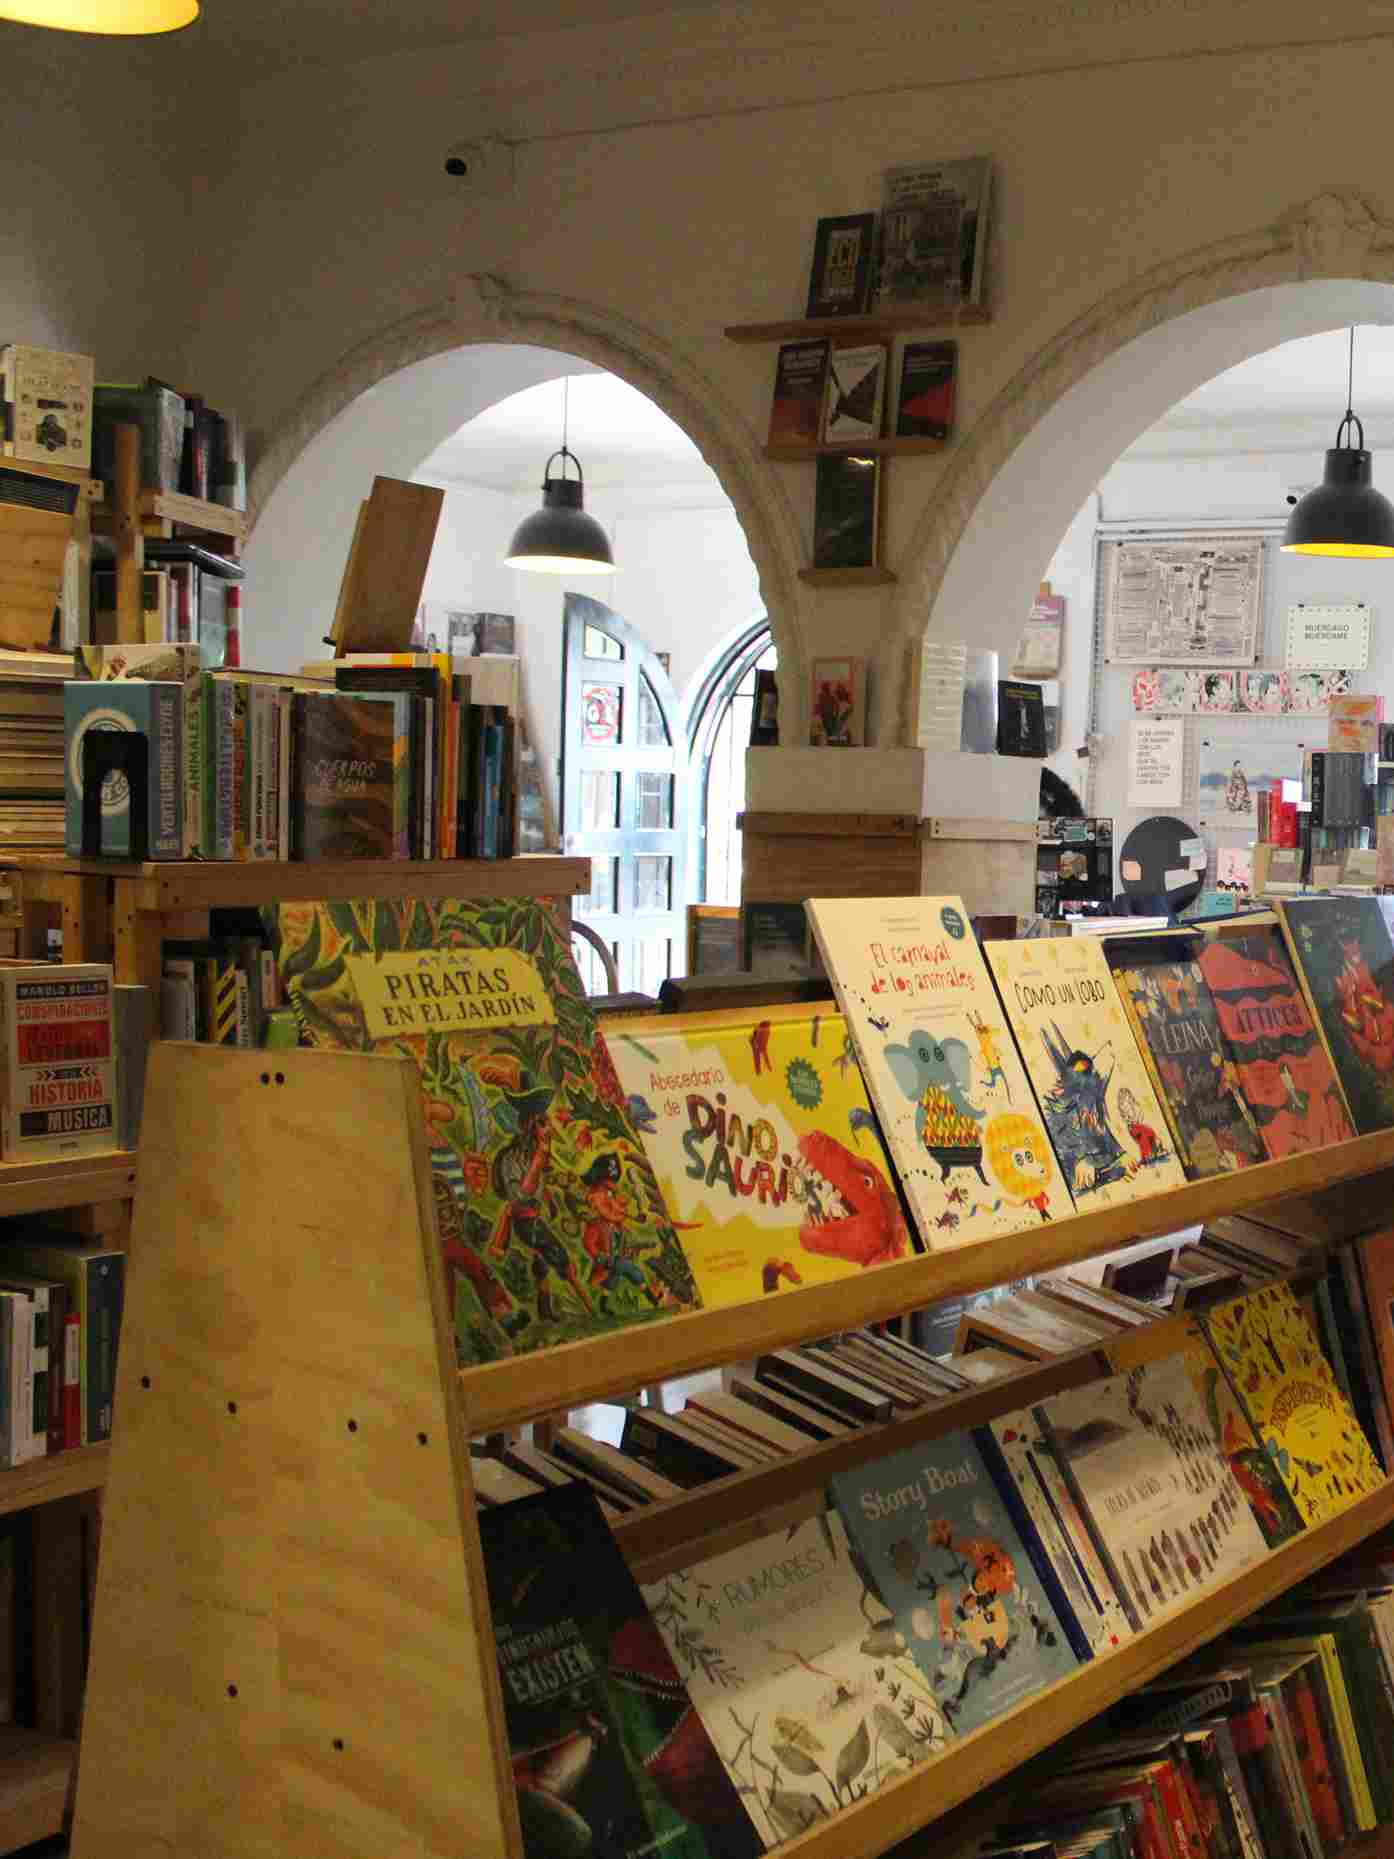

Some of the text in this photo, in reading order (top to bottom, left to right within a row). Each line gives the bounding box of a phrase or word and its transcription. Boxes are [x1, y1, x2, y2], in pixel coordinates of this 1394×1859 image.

[870, 940, 952, 968] El carnaval
[385, 967, 510, 1001] PIRATAS
[870, 971, 887, 994] de
[917, 967, 977, 993] animales
[1014, 977, 1106, 1014] COMO UN LOBO
[383, 993, 537, 1027] EN EL JARDÍN
[1160, 1019, 1213, 1055] LEINA
[29, 1078, 104, 1105] HISTORIA
[649, 1067, 725, 1092] Abecedario
[663, 1097, 682, 1118] de
[861, 1460, 978, 1520] Story Boat
